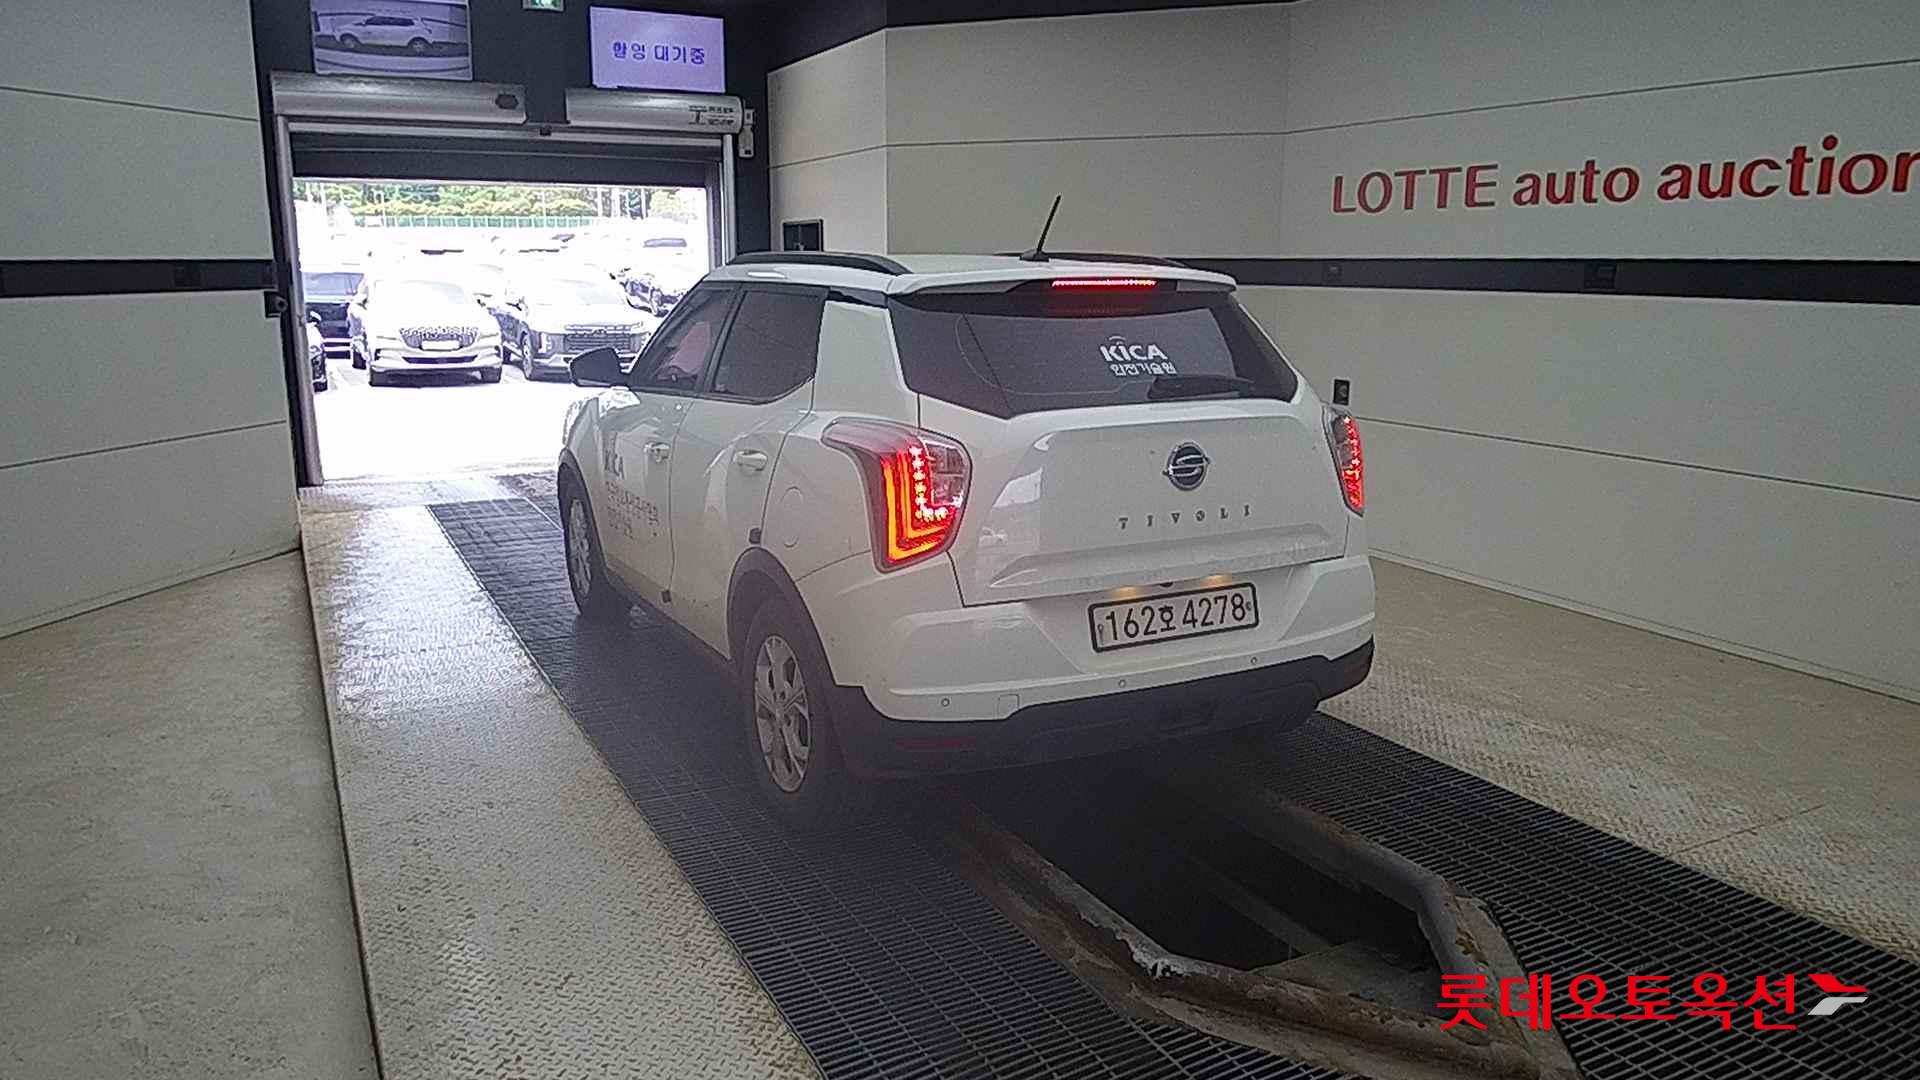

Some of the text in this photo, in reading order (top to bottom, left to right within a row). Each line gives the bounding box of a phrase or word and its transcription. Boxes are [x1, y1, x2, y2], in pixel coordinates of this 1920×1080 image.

[1331, 163, 1499, 215] LOTTE
[1512, 158, 1641, 208] auto
[1118, 503, 1251, 530] TIVOLI
[1182, 593, 1247, 629] 4278
